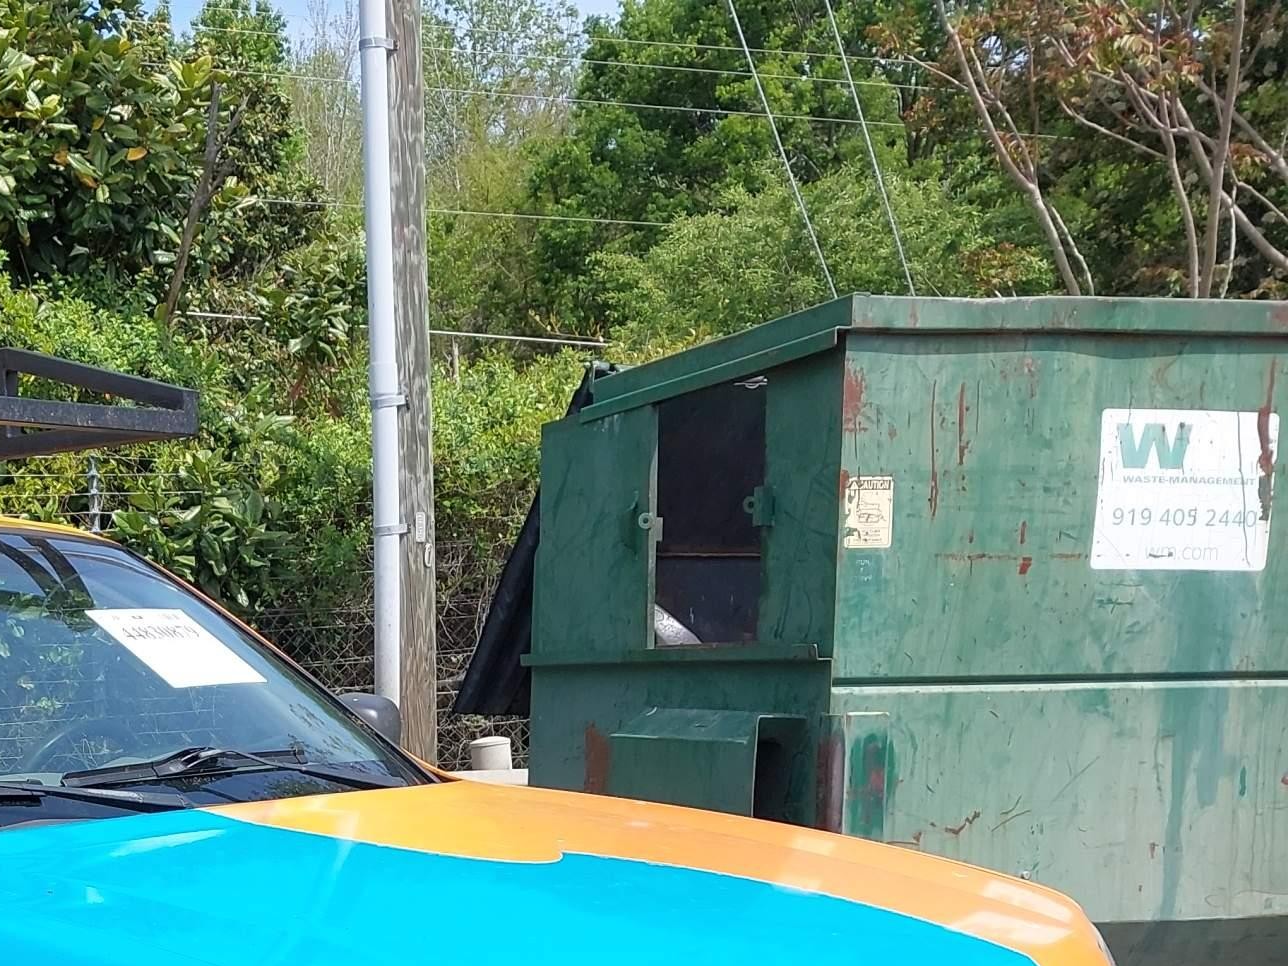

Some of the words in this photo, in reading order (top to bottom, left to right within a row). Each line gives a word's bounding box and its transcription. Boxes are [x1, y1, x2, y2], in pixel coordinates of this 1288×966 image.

[1112, 508, 1152, 526] 919
[1205, 509, 1257, 528] 2440
[1145, 546, 1218, 561] wm.com
